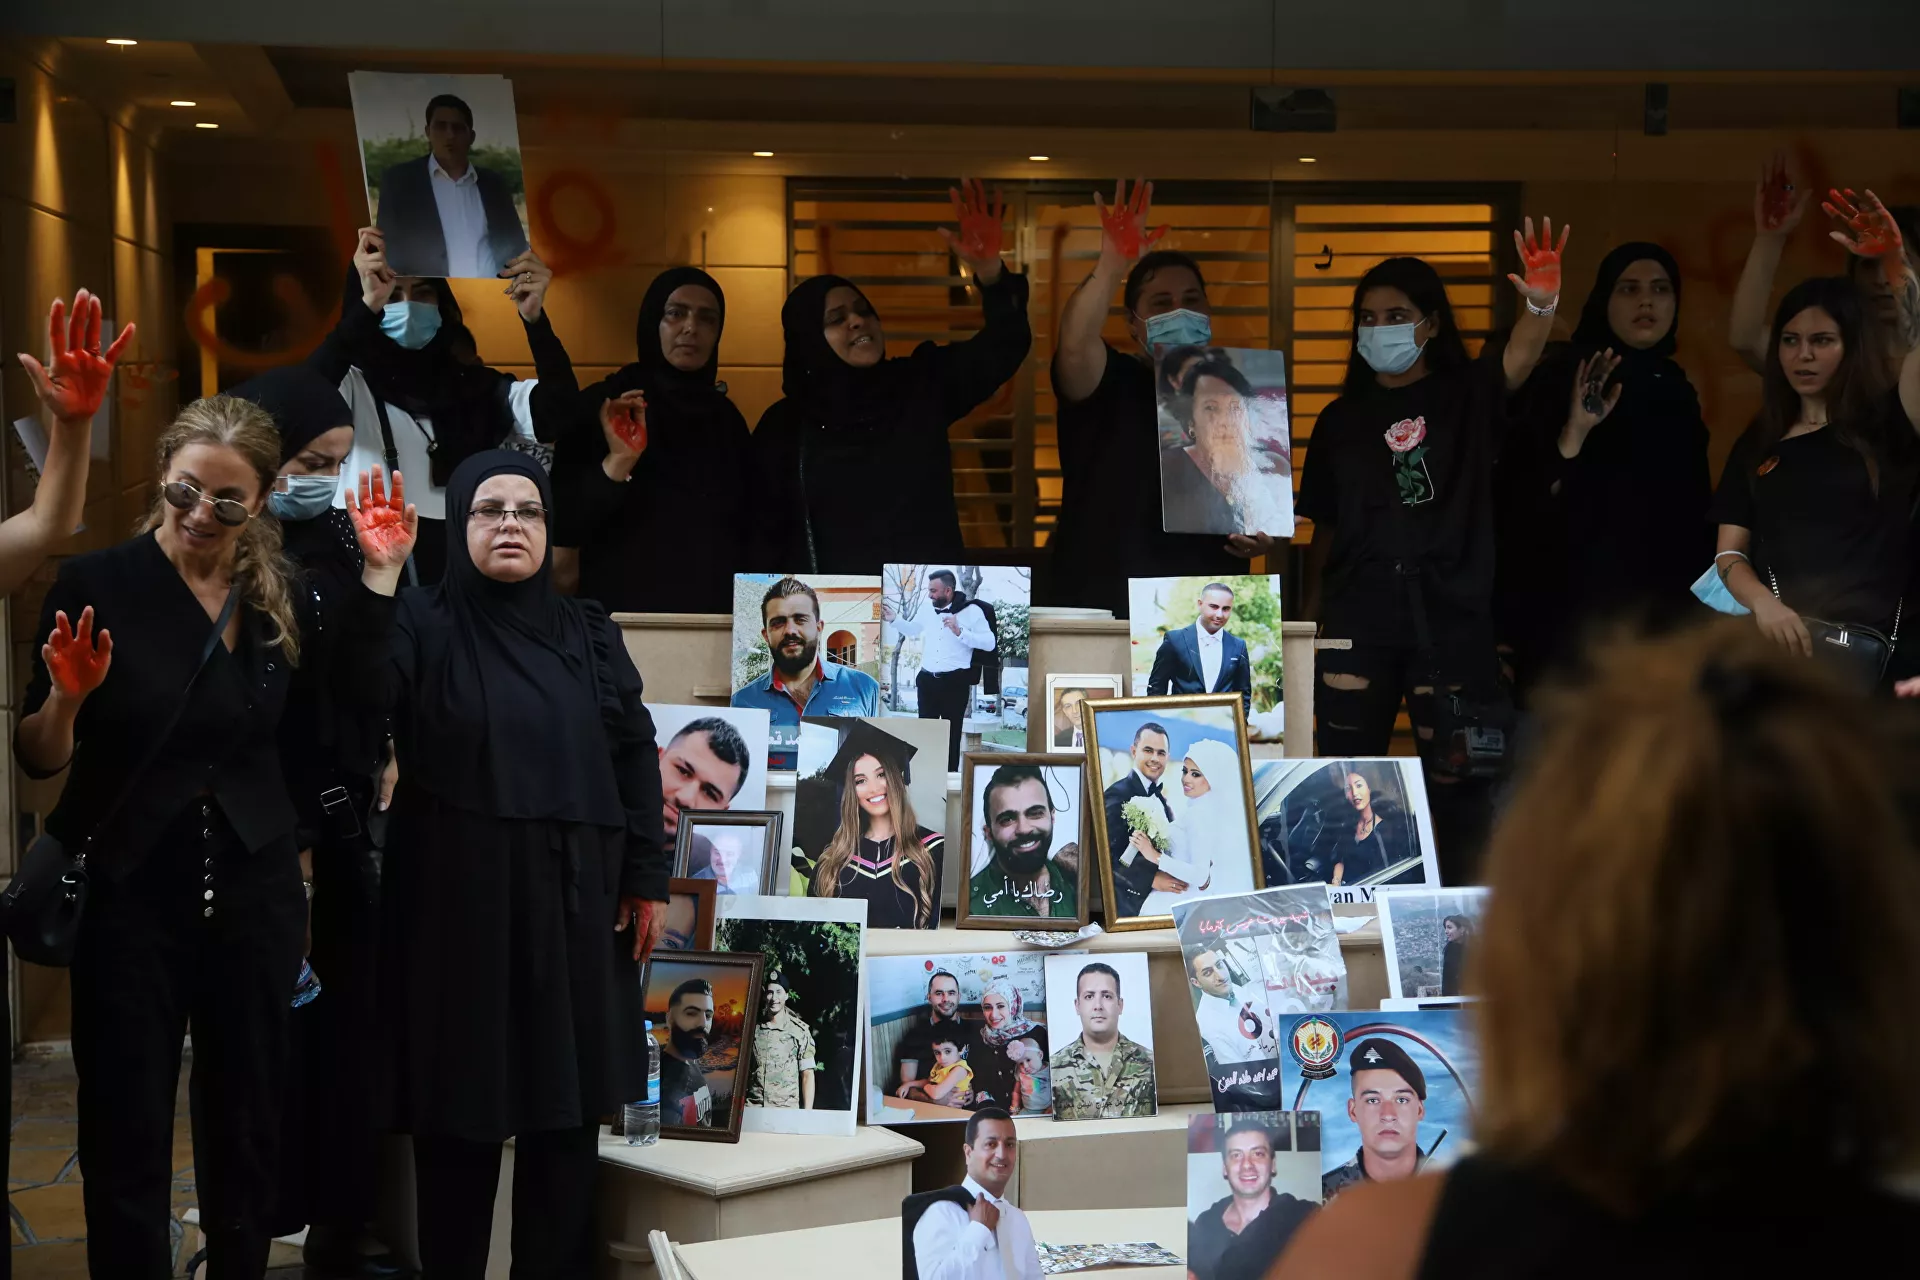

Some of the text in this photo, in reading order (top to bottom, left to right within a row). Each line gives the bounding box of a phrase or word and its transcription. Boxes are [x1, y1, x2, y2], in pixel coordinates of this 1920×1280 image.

[983, 875, 1063, 908] رضاك يا أمي
